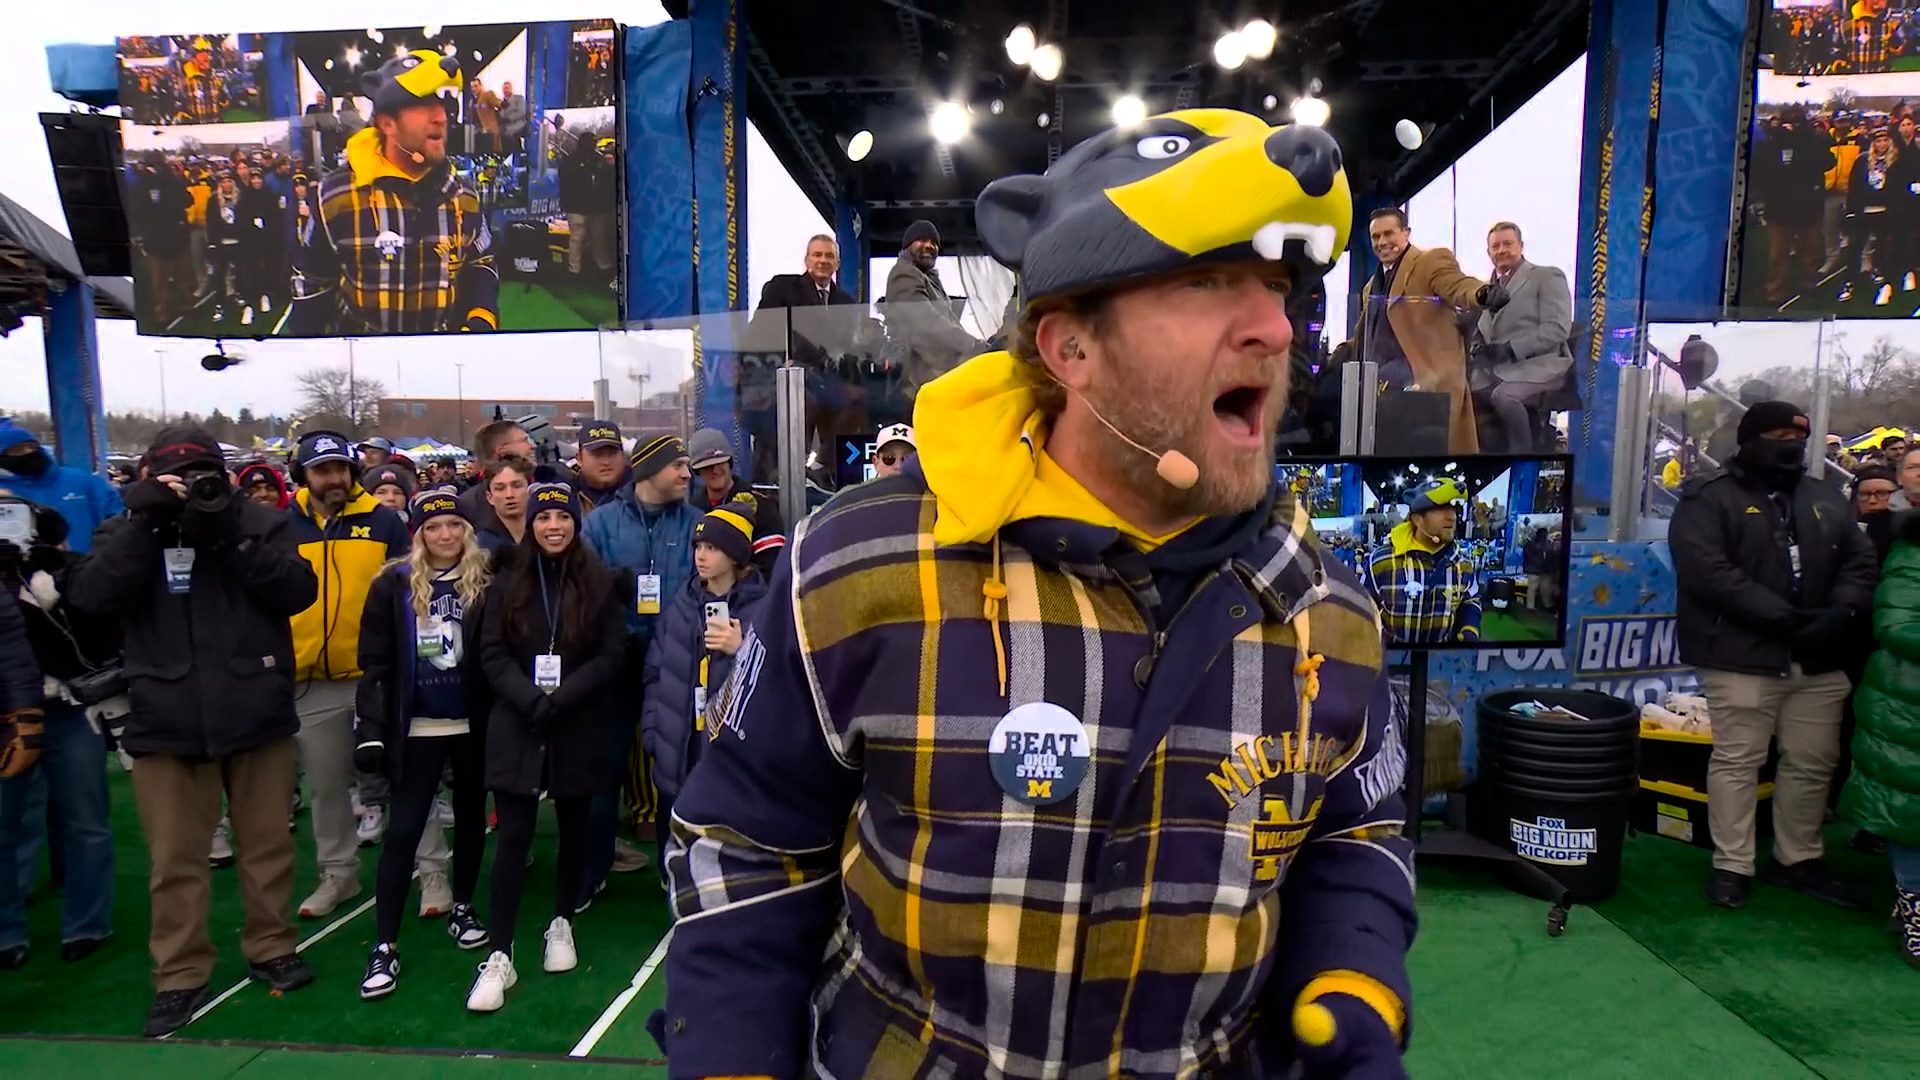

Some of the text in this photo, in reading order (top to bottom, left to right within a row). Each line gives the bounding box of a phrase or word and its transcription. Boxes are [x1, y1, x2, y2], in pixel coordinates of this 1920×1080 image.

[891, 428, 909, 437] M
[350, 525, 371, 538] M
[1580, 620, 1648, 670] BIG
[1004, 731, 1078, 757] BEAT
[1023, 753, 1057, 766] OHIO
[1016, 764, 1064, 779] STATE
[1027, 780, 1052, 798] M
[1538, 817, 1564, 829] FOX
[1512, 822, 1594, 849] BIG NOON
[1519, 844, 1588, 861] KICKOFF
